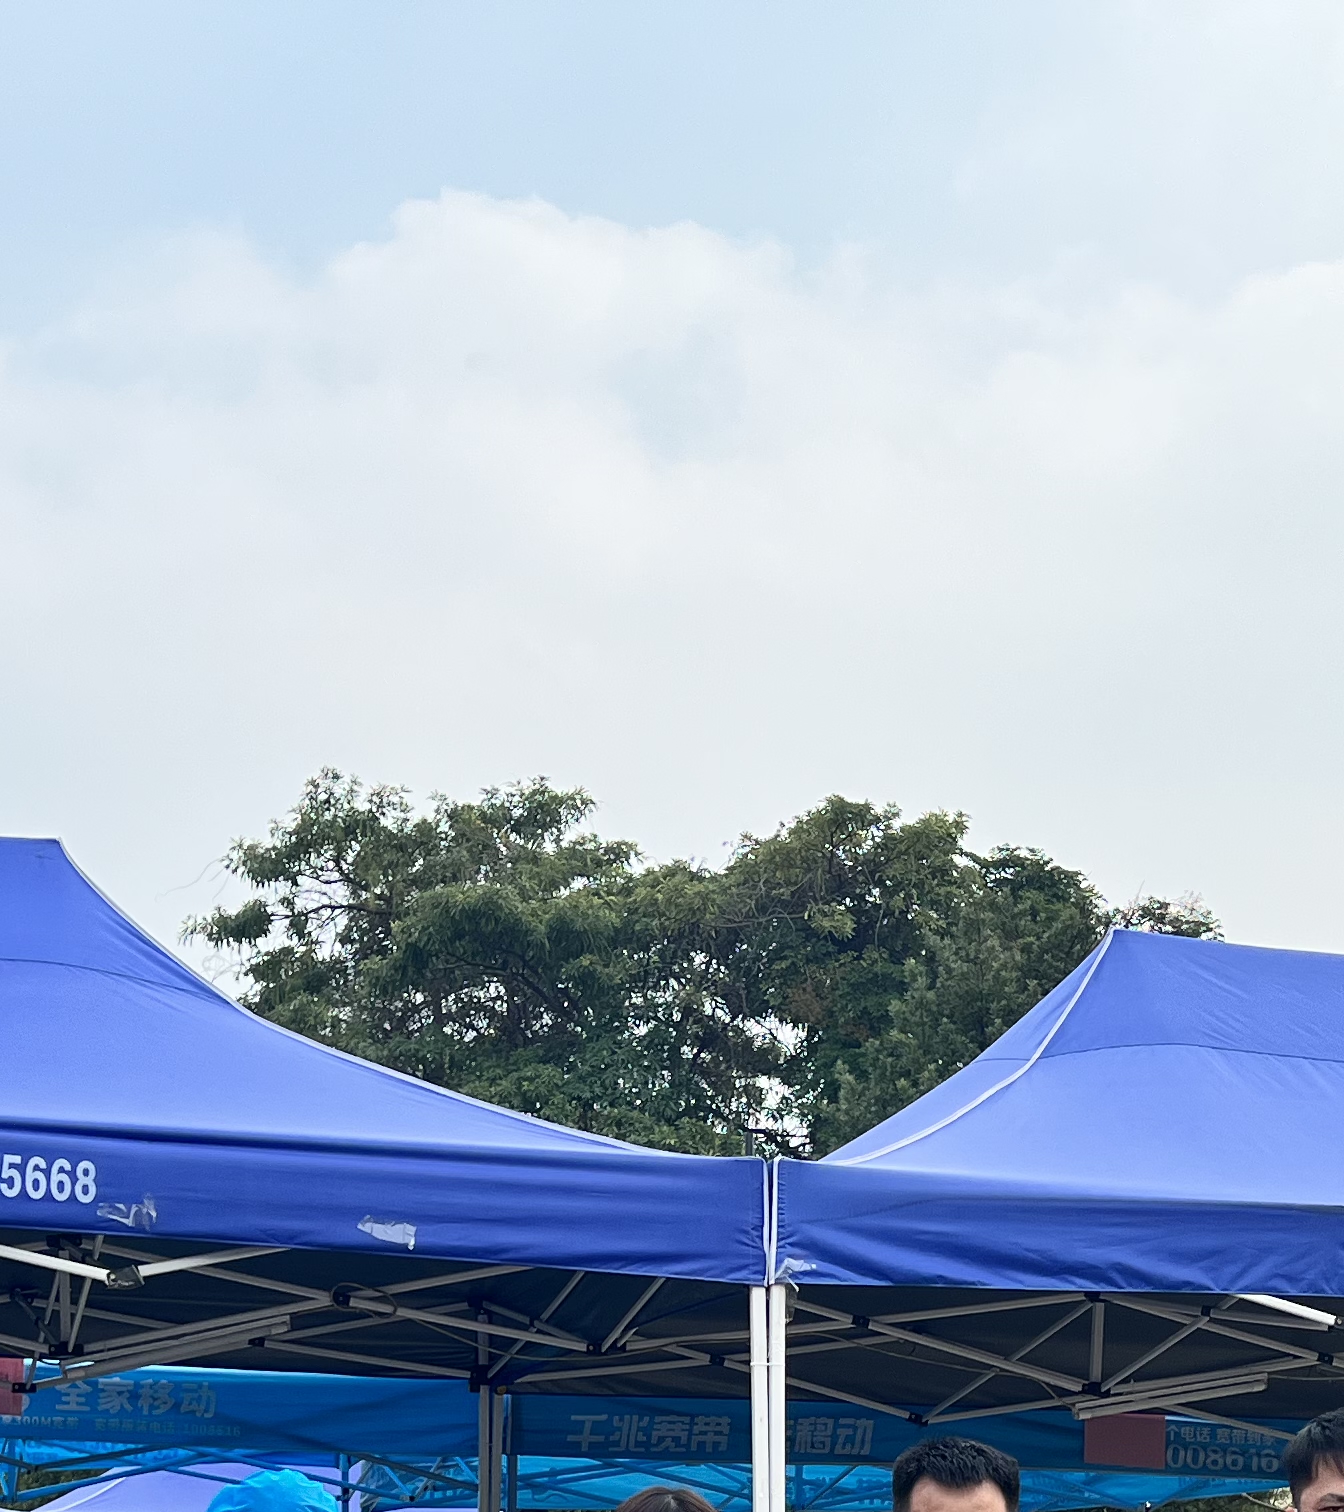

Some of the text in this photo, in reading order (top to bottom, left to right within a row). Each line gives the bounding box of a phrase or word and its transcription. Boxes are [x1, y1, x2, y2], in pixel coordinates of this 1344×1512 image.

[55, 1377, 218, 1419] 全家移动
[567, 1414, 875, 1455] 千兆宽带 移动
